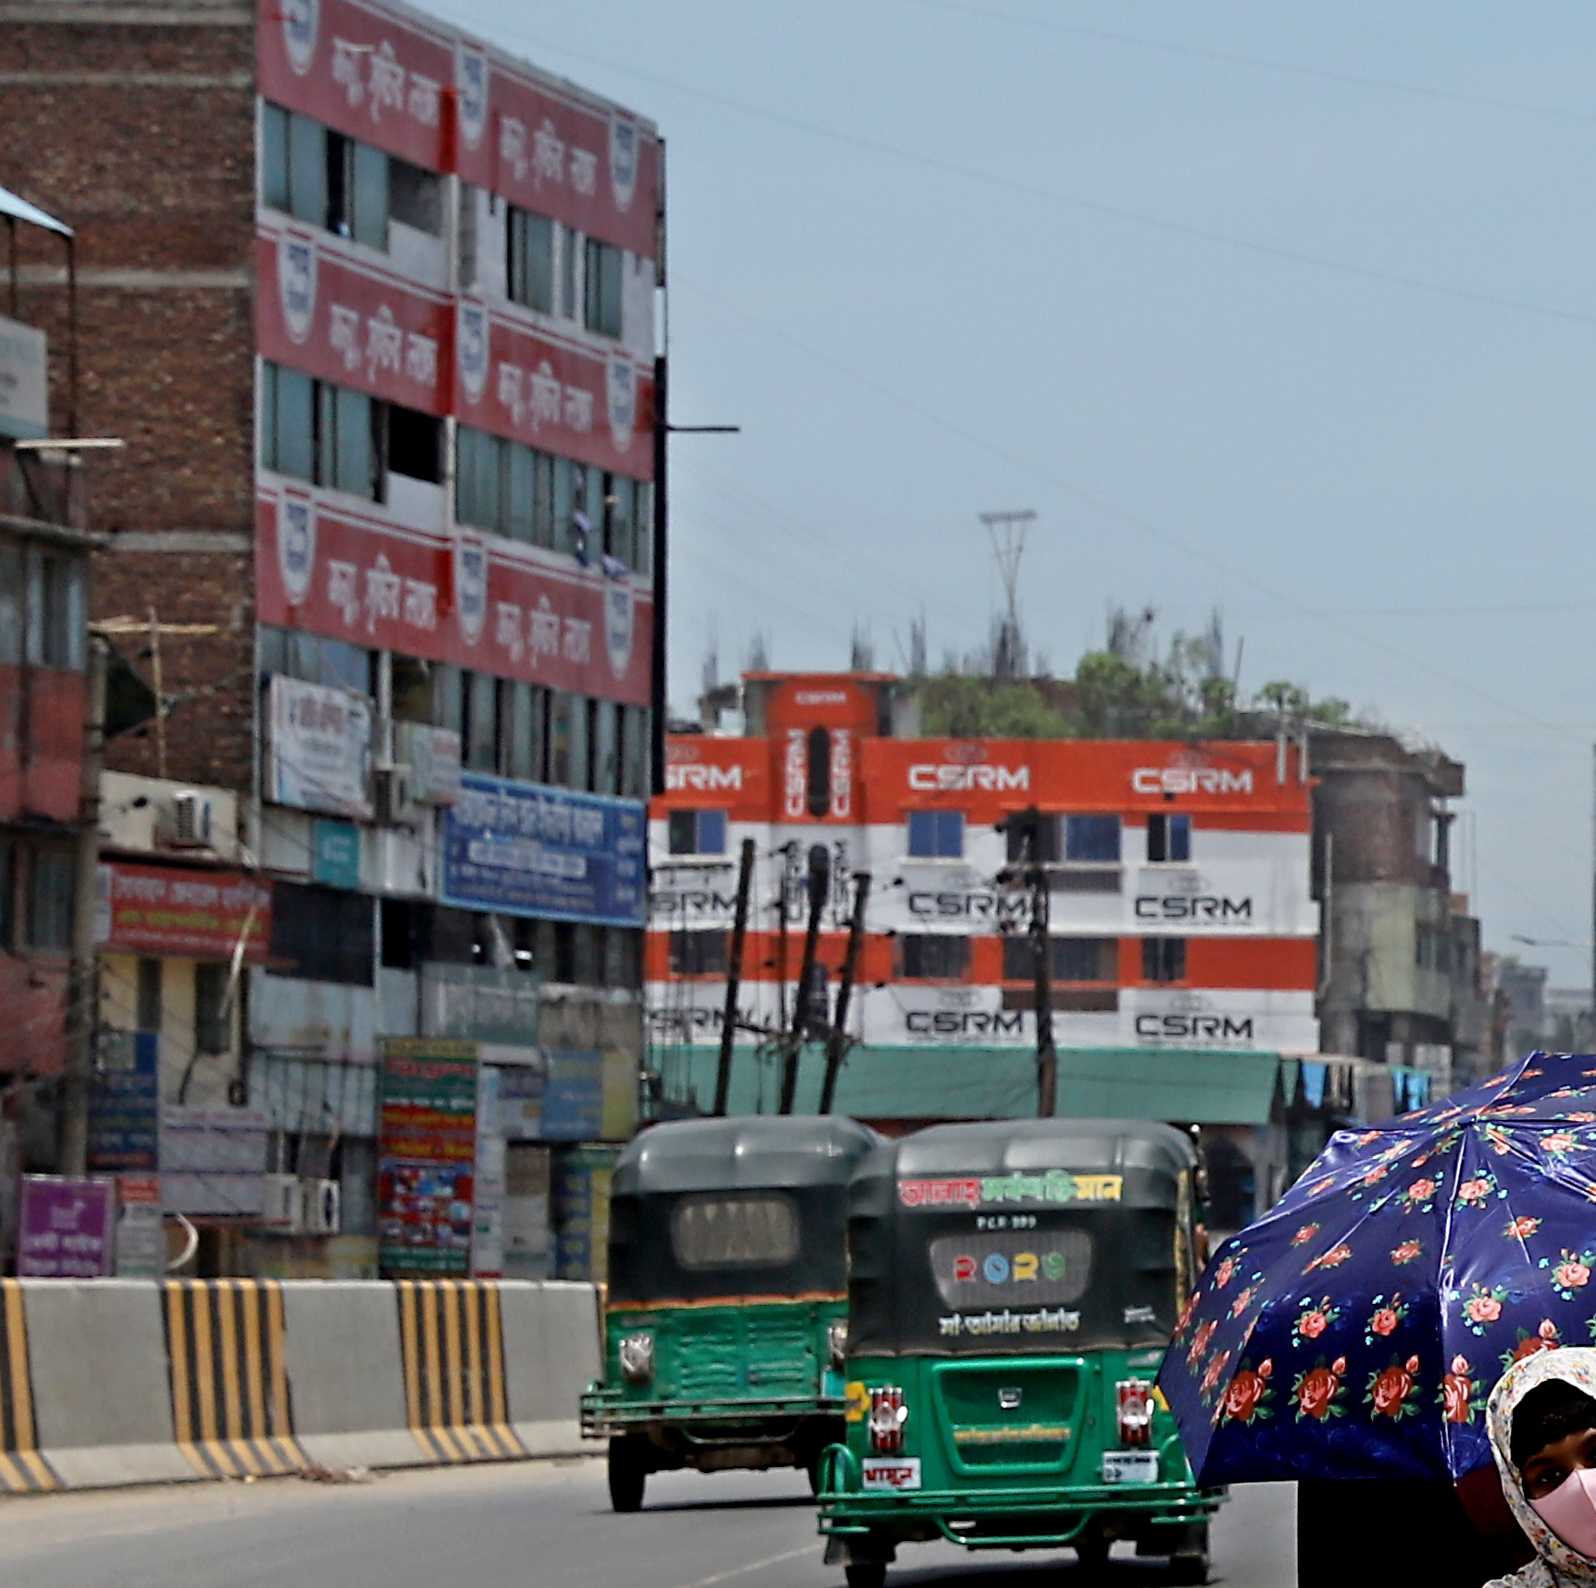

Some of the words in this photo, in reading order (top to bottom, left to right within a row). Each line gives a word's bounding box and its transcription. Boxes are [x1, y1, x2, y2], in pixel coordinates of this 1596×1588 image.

[786, 728, 806, 818] CSRM
[831, 728, 851, 818] CSRM
[907, 764, 1031, 792] CSRM
[1131, 767, 1254, 796] CSRM
[908, 891, 1031, 917] CSRM
[1134, 894, 1253, 919] CSRM
[905, 1010, 1024, 1034] CSRM
[1135, 1013, 1254, 1038] CSRM
